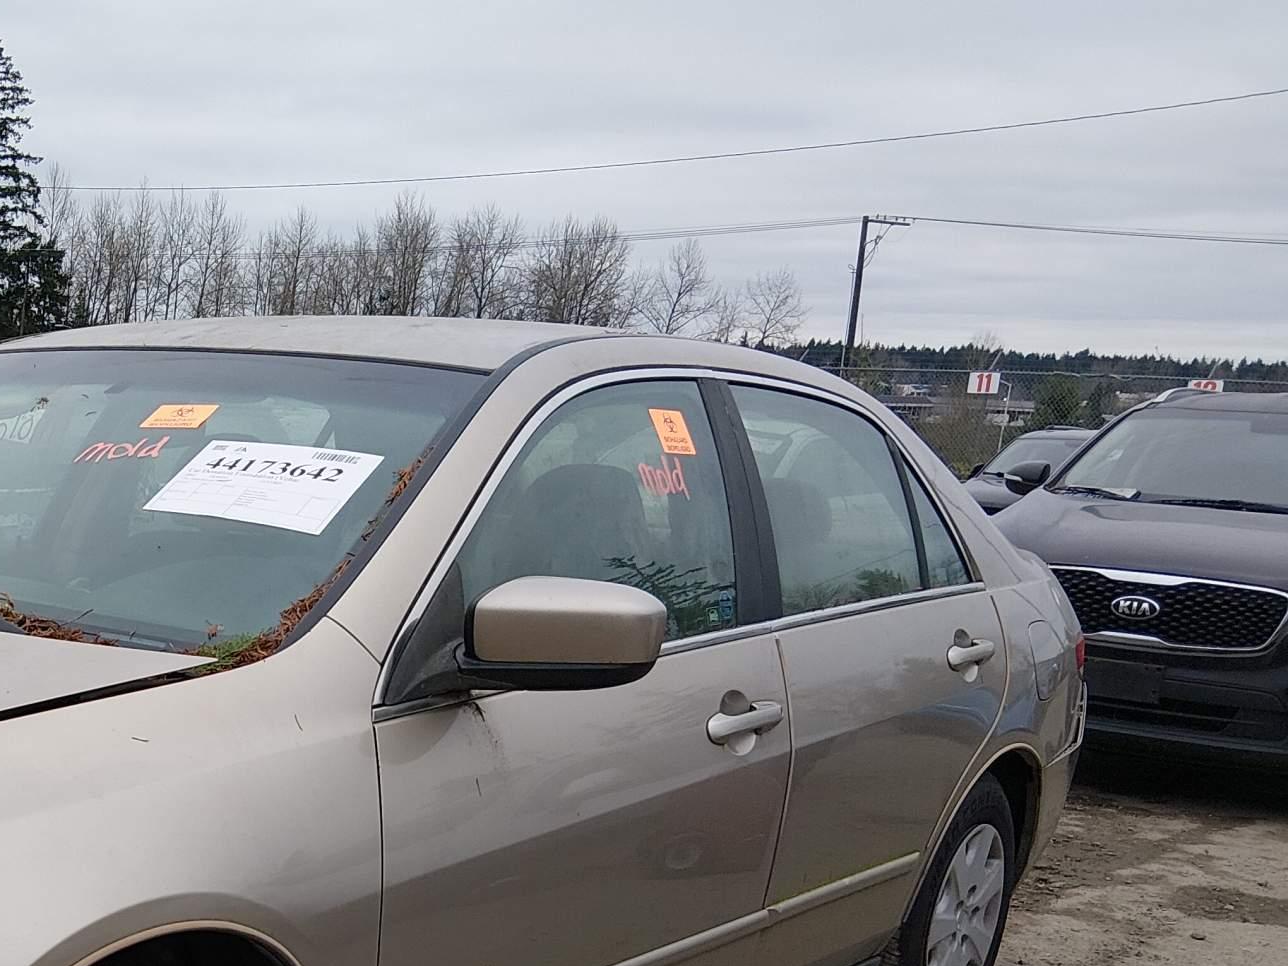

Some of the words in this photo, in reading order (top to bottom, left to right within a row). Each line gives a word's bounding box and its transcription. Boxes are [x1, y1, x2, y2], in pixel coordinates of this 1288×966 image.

[976, 373, 993, 393] 11
[205, 456, 344, 482] 44173642
[1118, 600, 1151, 616] KIA
